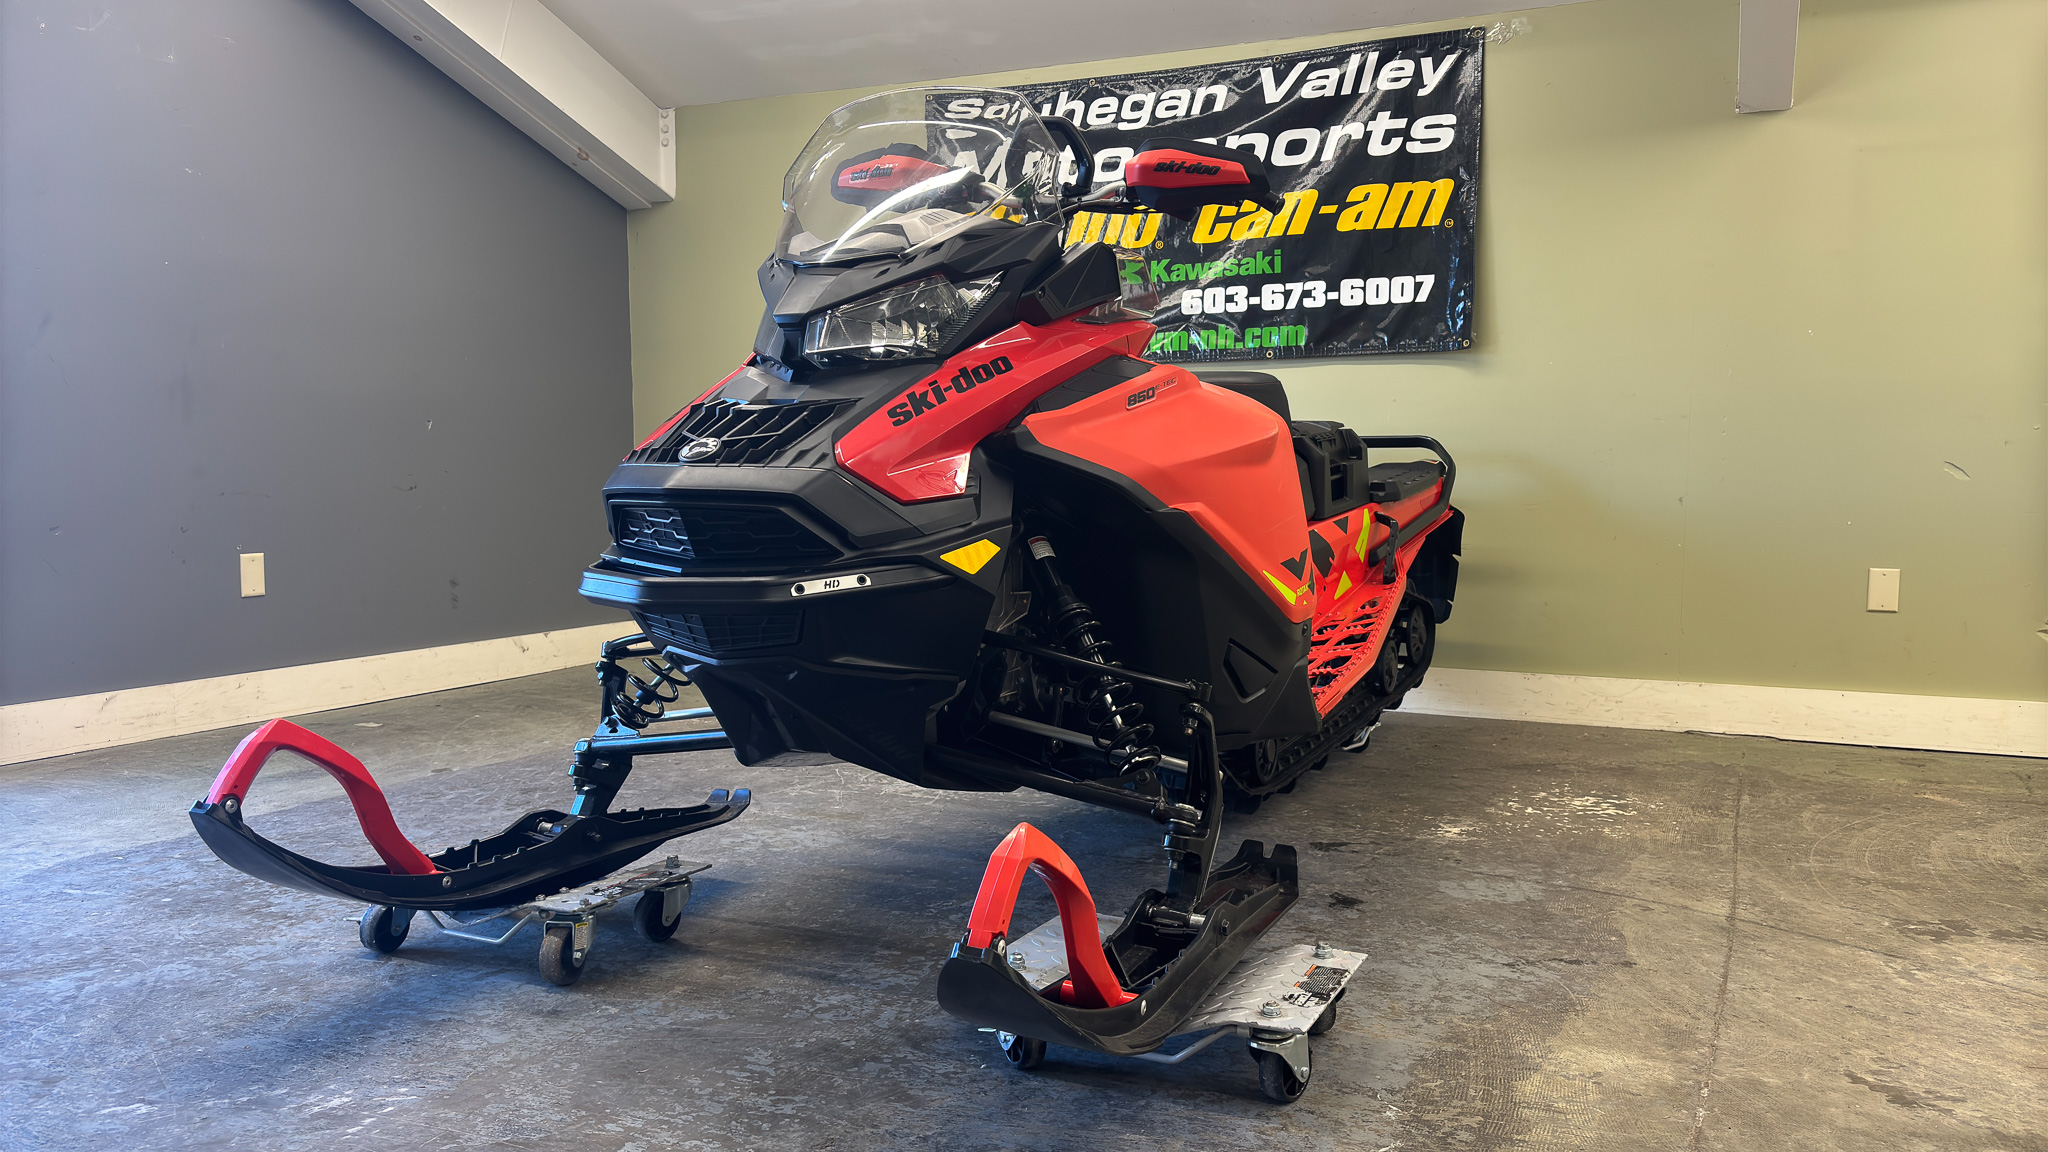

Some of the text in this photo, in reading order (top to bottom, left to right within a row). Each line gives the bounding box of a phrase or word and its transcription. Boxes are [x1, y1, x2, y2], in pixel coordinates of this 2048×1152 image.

[1259, 51, 1458, 104] Valley
[1153, 160, 1221, 176] ski-doo
[1192, 179, 1454, 244] can-am
[1151, 249, 1281, 283] Kawasaki
[1181, 274, 1435, 315] 603-673-6007
[1144, 324, 1305, 352] vm-nh.com
[887, 356, 1013, 427] ski-doo
[1128, 386, 1155, 407] 850
[824, 580, 840, 589] HD
